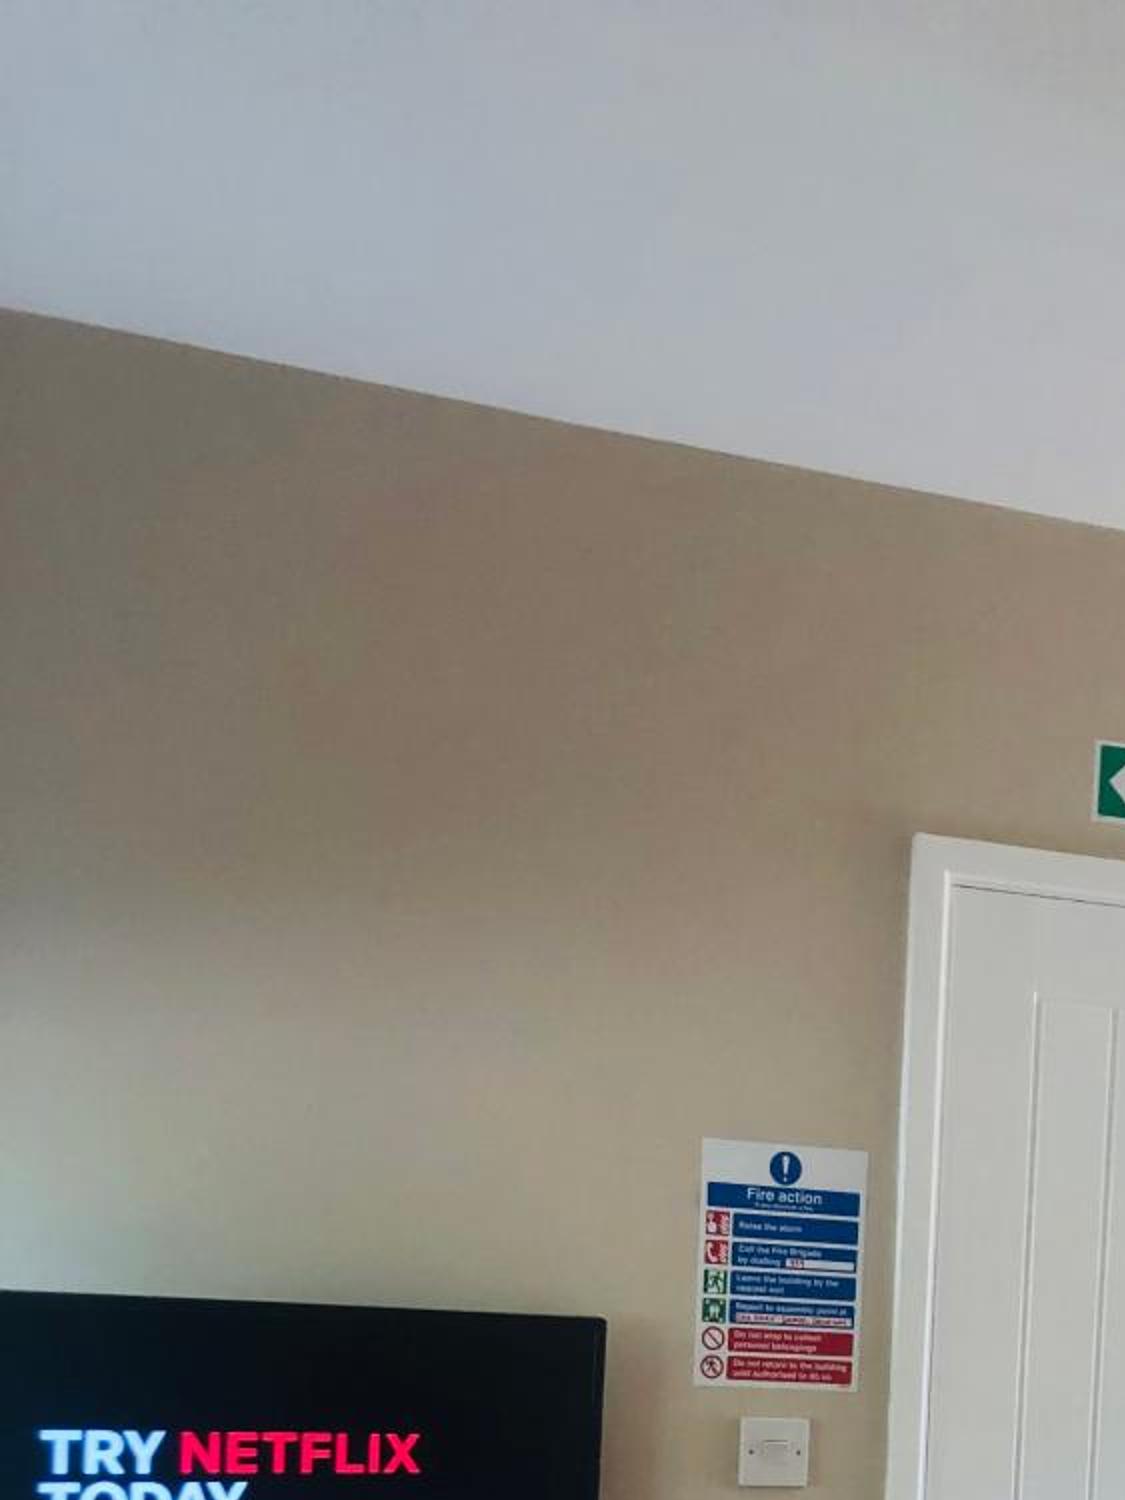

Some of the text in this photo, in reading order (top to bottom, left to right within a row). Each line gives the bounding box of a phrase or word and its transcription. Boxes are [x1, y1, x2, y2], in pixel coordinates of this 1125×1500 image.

[747, 1187, 822, 1205] Fire action
[739, 1221, 762, 1230] Raise
[764, 1223, 778, 1231] the
[738, 1245, 755, 1254] Call
[756, 1246, 770, 1254] the
[38, 1429, 422, 1476] TRY NETFLIX
